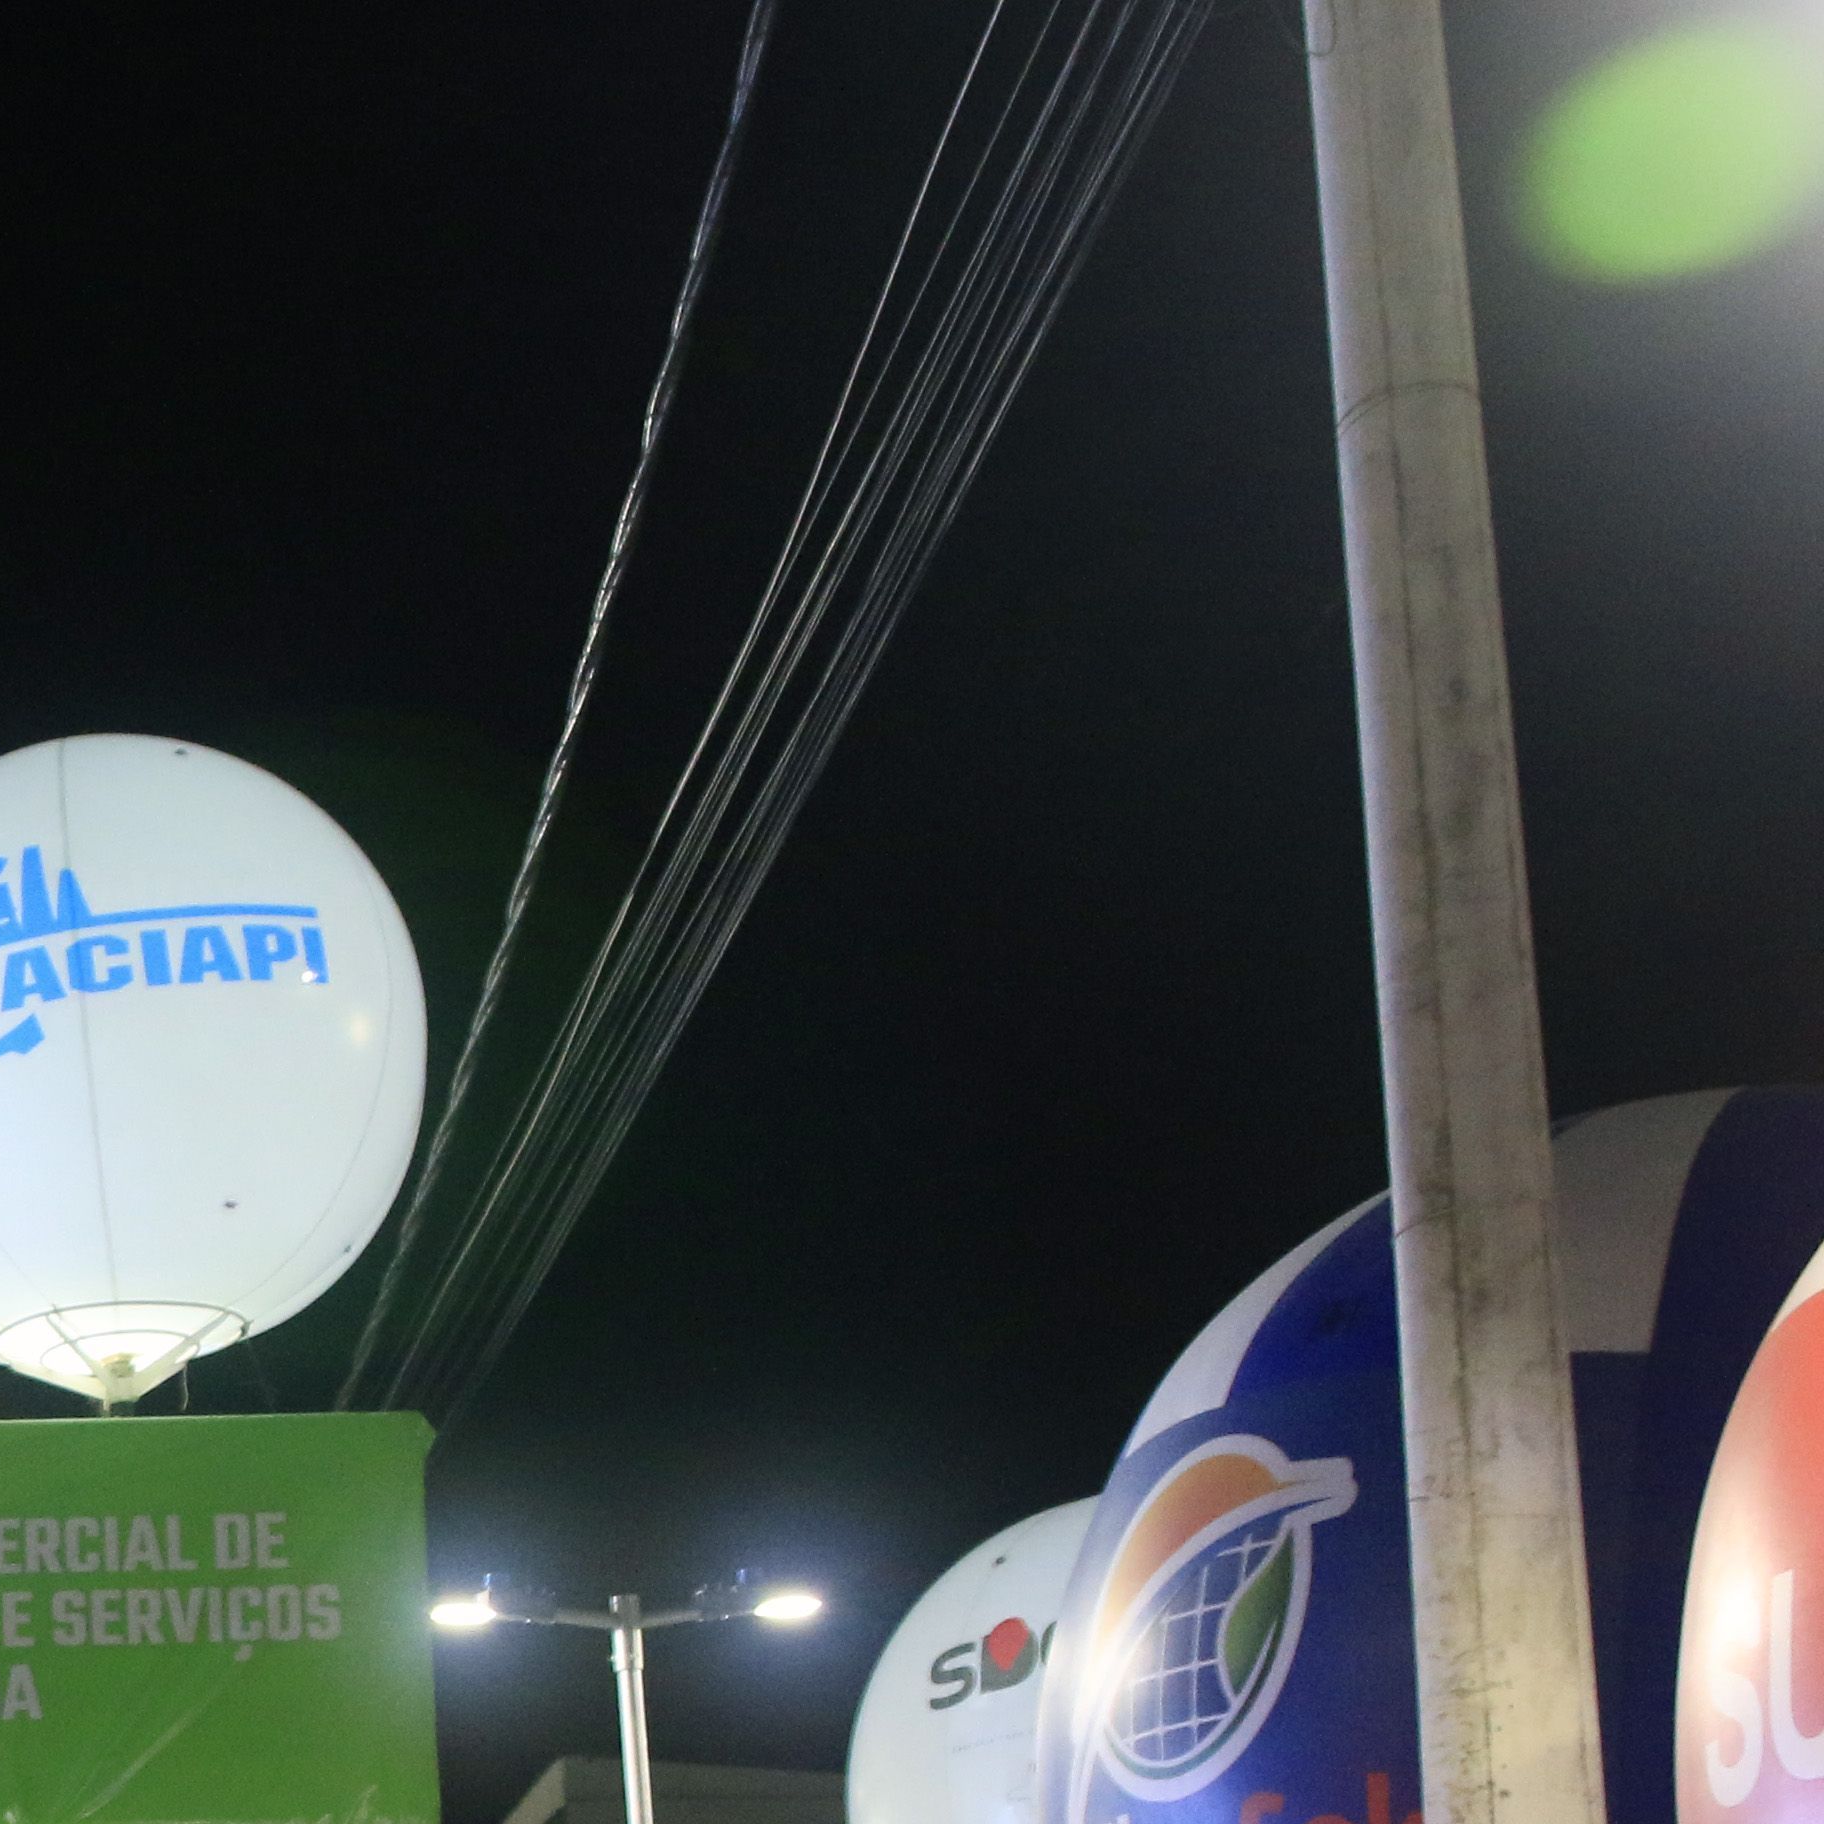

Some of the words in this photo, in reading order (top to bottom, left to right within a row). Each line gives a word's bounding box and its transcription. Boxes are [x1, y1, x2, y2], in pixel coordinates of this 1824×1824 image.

[1, 924, 329, 1011] ACIAPI
[213, 1512, 290, 1570] DE
[2, 1591, 35, 1647] E
[51, 1584, 343, 1664] SERVIÇOS
